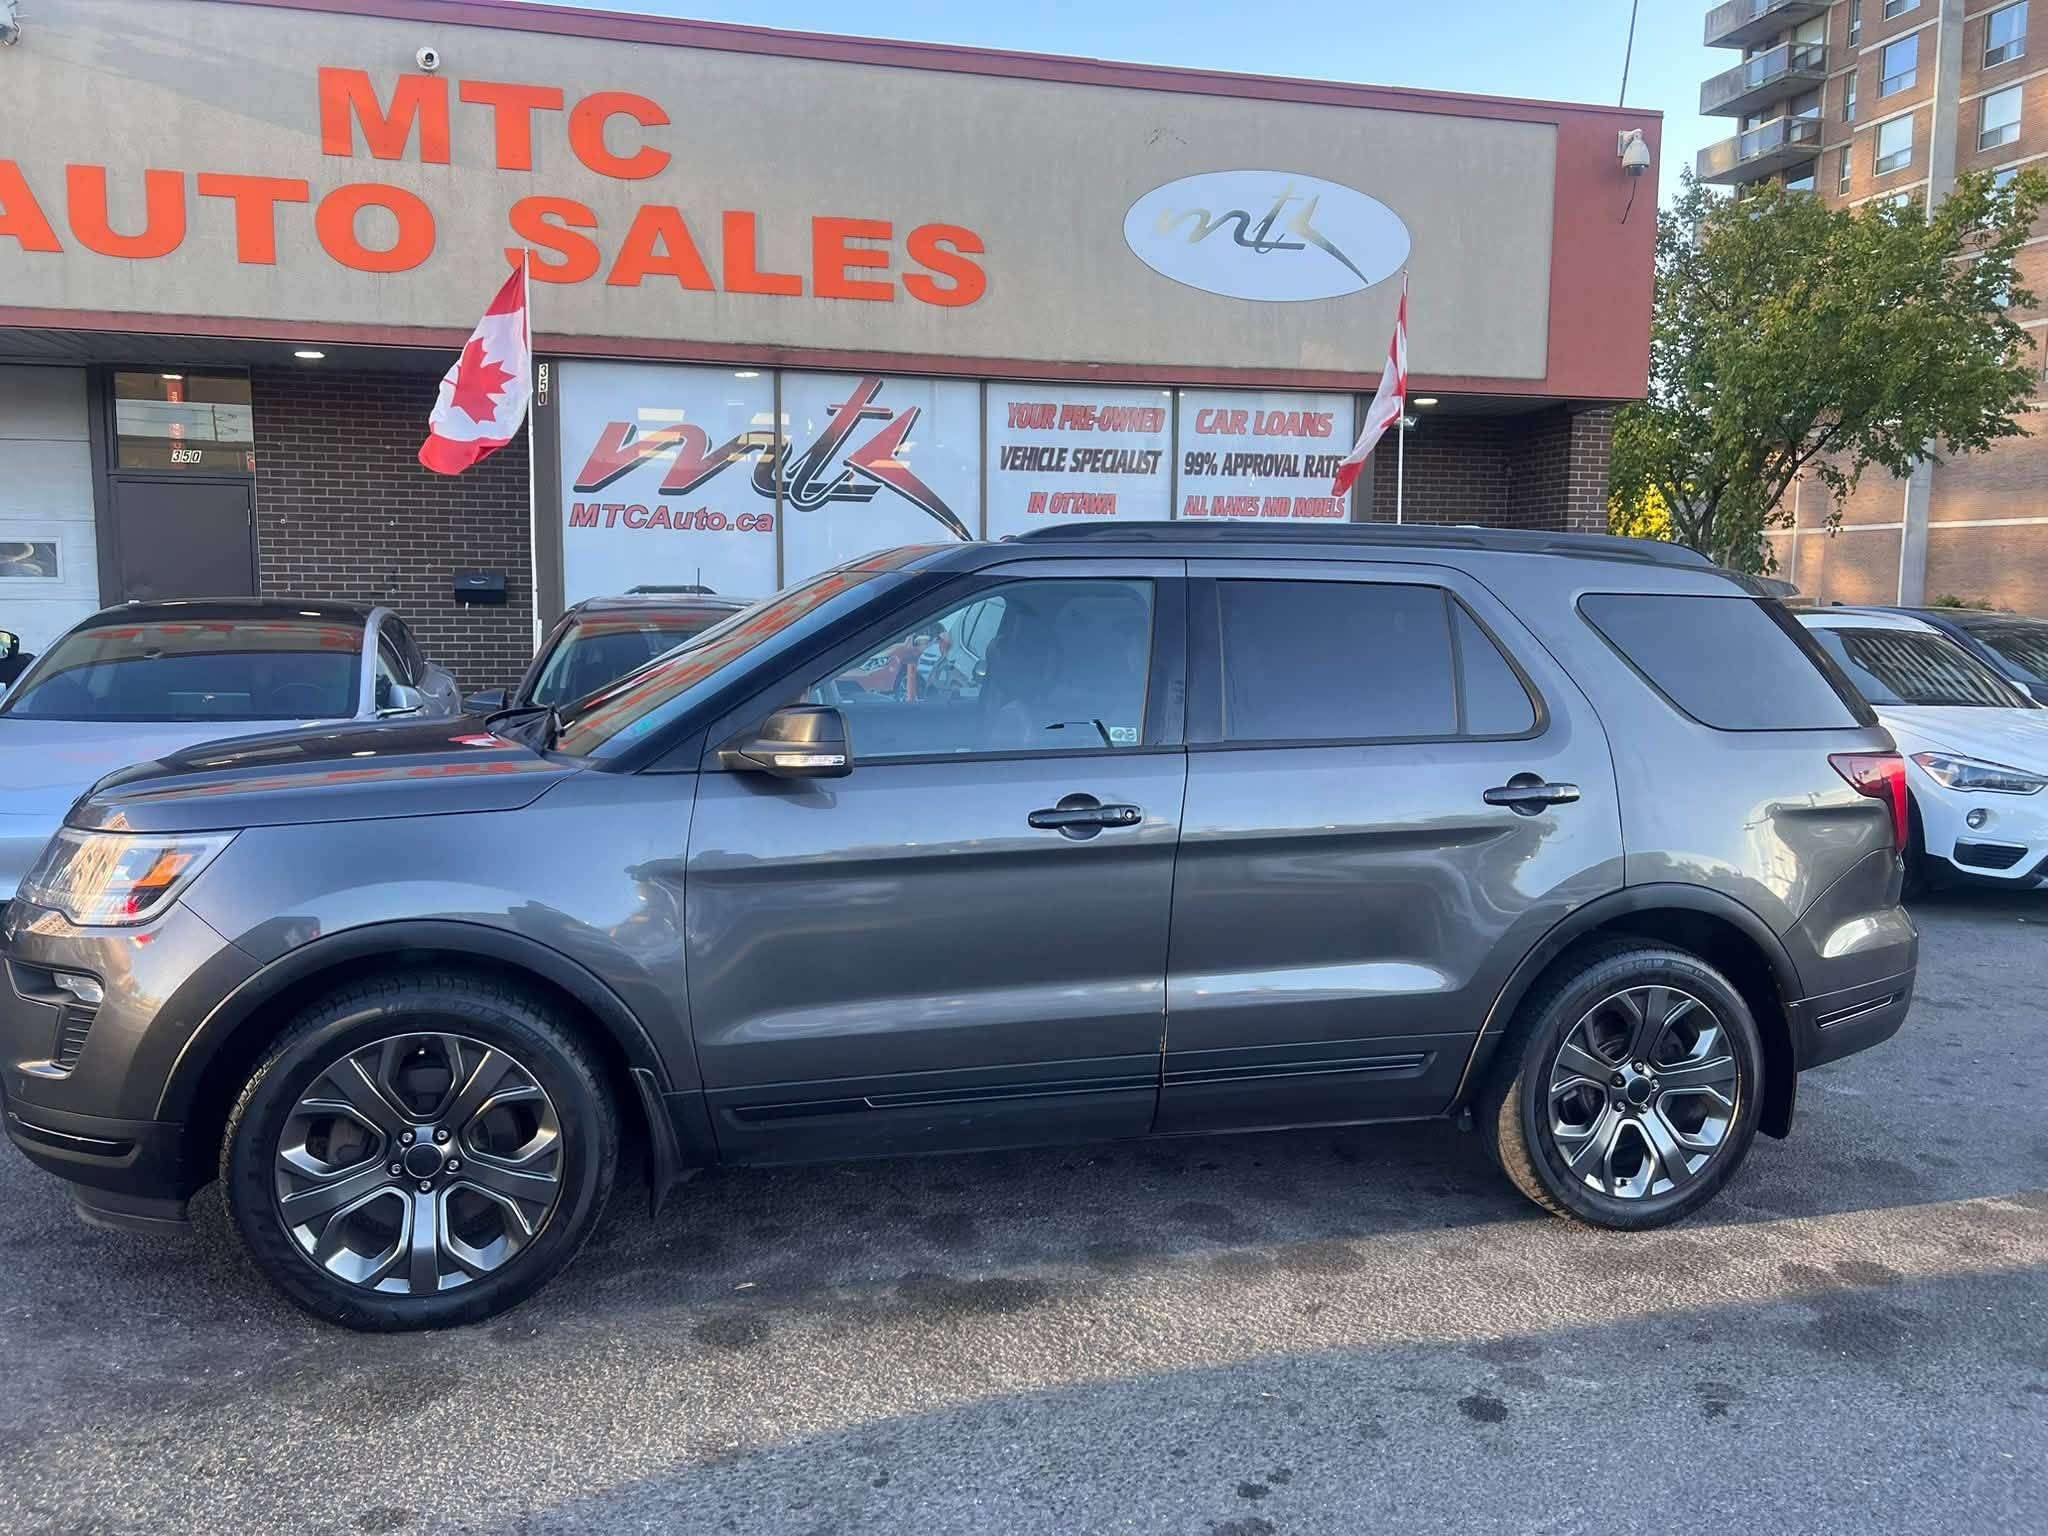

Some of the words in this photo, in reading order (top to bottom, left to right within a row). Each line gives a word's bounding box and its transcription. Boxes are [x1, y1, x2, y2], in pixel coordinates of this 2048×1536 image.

[318, 67, 671, 180] MTC
[504, 195, 987, 307] SALES
[539, 363, 548, 406] 350
[1008, 402, 1057, 430] YOUR
[1058, 404, 1166, 433] PRE-OWNED
[1196, 408, 1248, 435] CAR
[1253, 410, 1334, 438] LOANS
[172, 450, 201, 463] 350
[1000, 445, 1068, 472] VEHICLE
[1069, 448, 1163, 475] SPECIALIST
[1184, 451, 1218, 476] 99%
[1221, 453, 1300, 478] APPROVAL
[569, 503, 774, 532] MTCAuto.ca
[1027, 491, 1048, 514] IN
[1050, 491, 1117, 515] OTTAWA
[1184, 495, 1209, 516] ALL
[1211, 495, 1260, 517] MAKES
[1261, 496, 1291, 517] AND
[1292, 496, 1345, 518] MODELS
